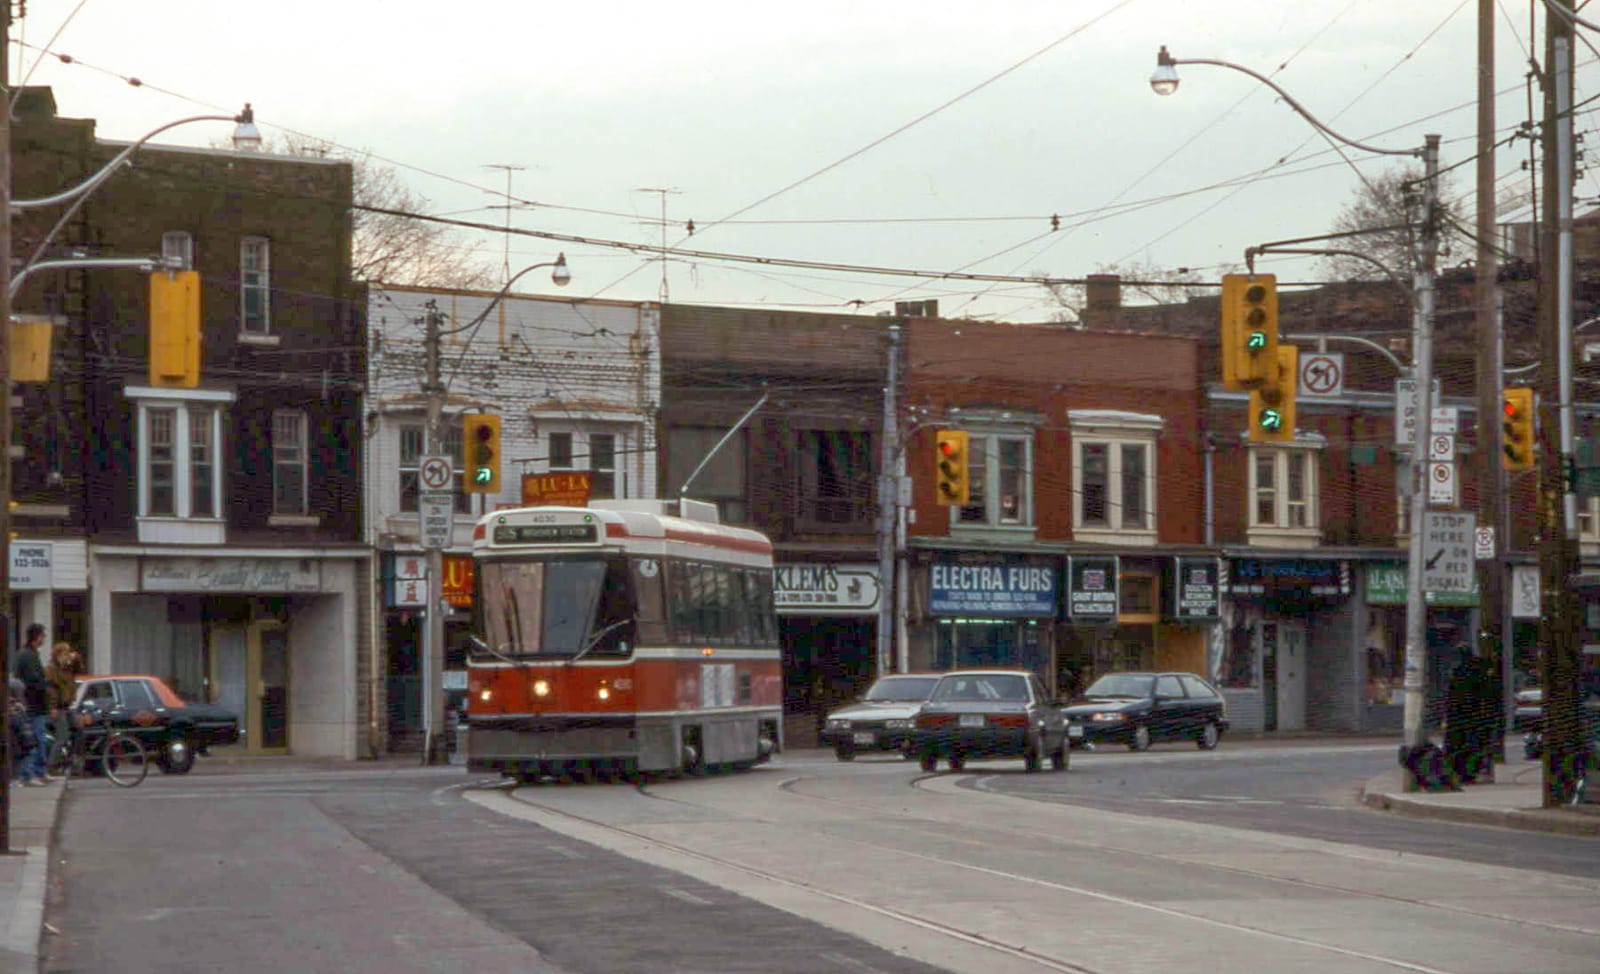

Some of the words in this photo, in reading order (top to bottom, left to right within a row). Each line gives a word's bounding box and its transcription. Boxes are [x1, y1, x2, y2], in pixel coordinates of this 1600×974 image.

[1432, 516, 1464, 527] STOP
[1431, 531, 1464, 542] HERE
[19, 549, 44, 557] PHONE
[1454, 547, 1468, 557] ON
[1446, 562, 1468, 573] RED
[932, 565, 1004, 589] ELECTRA
[1008, 567, 1052, 592] FURS
[1427, 577, 1466, 589] SIGNAL
